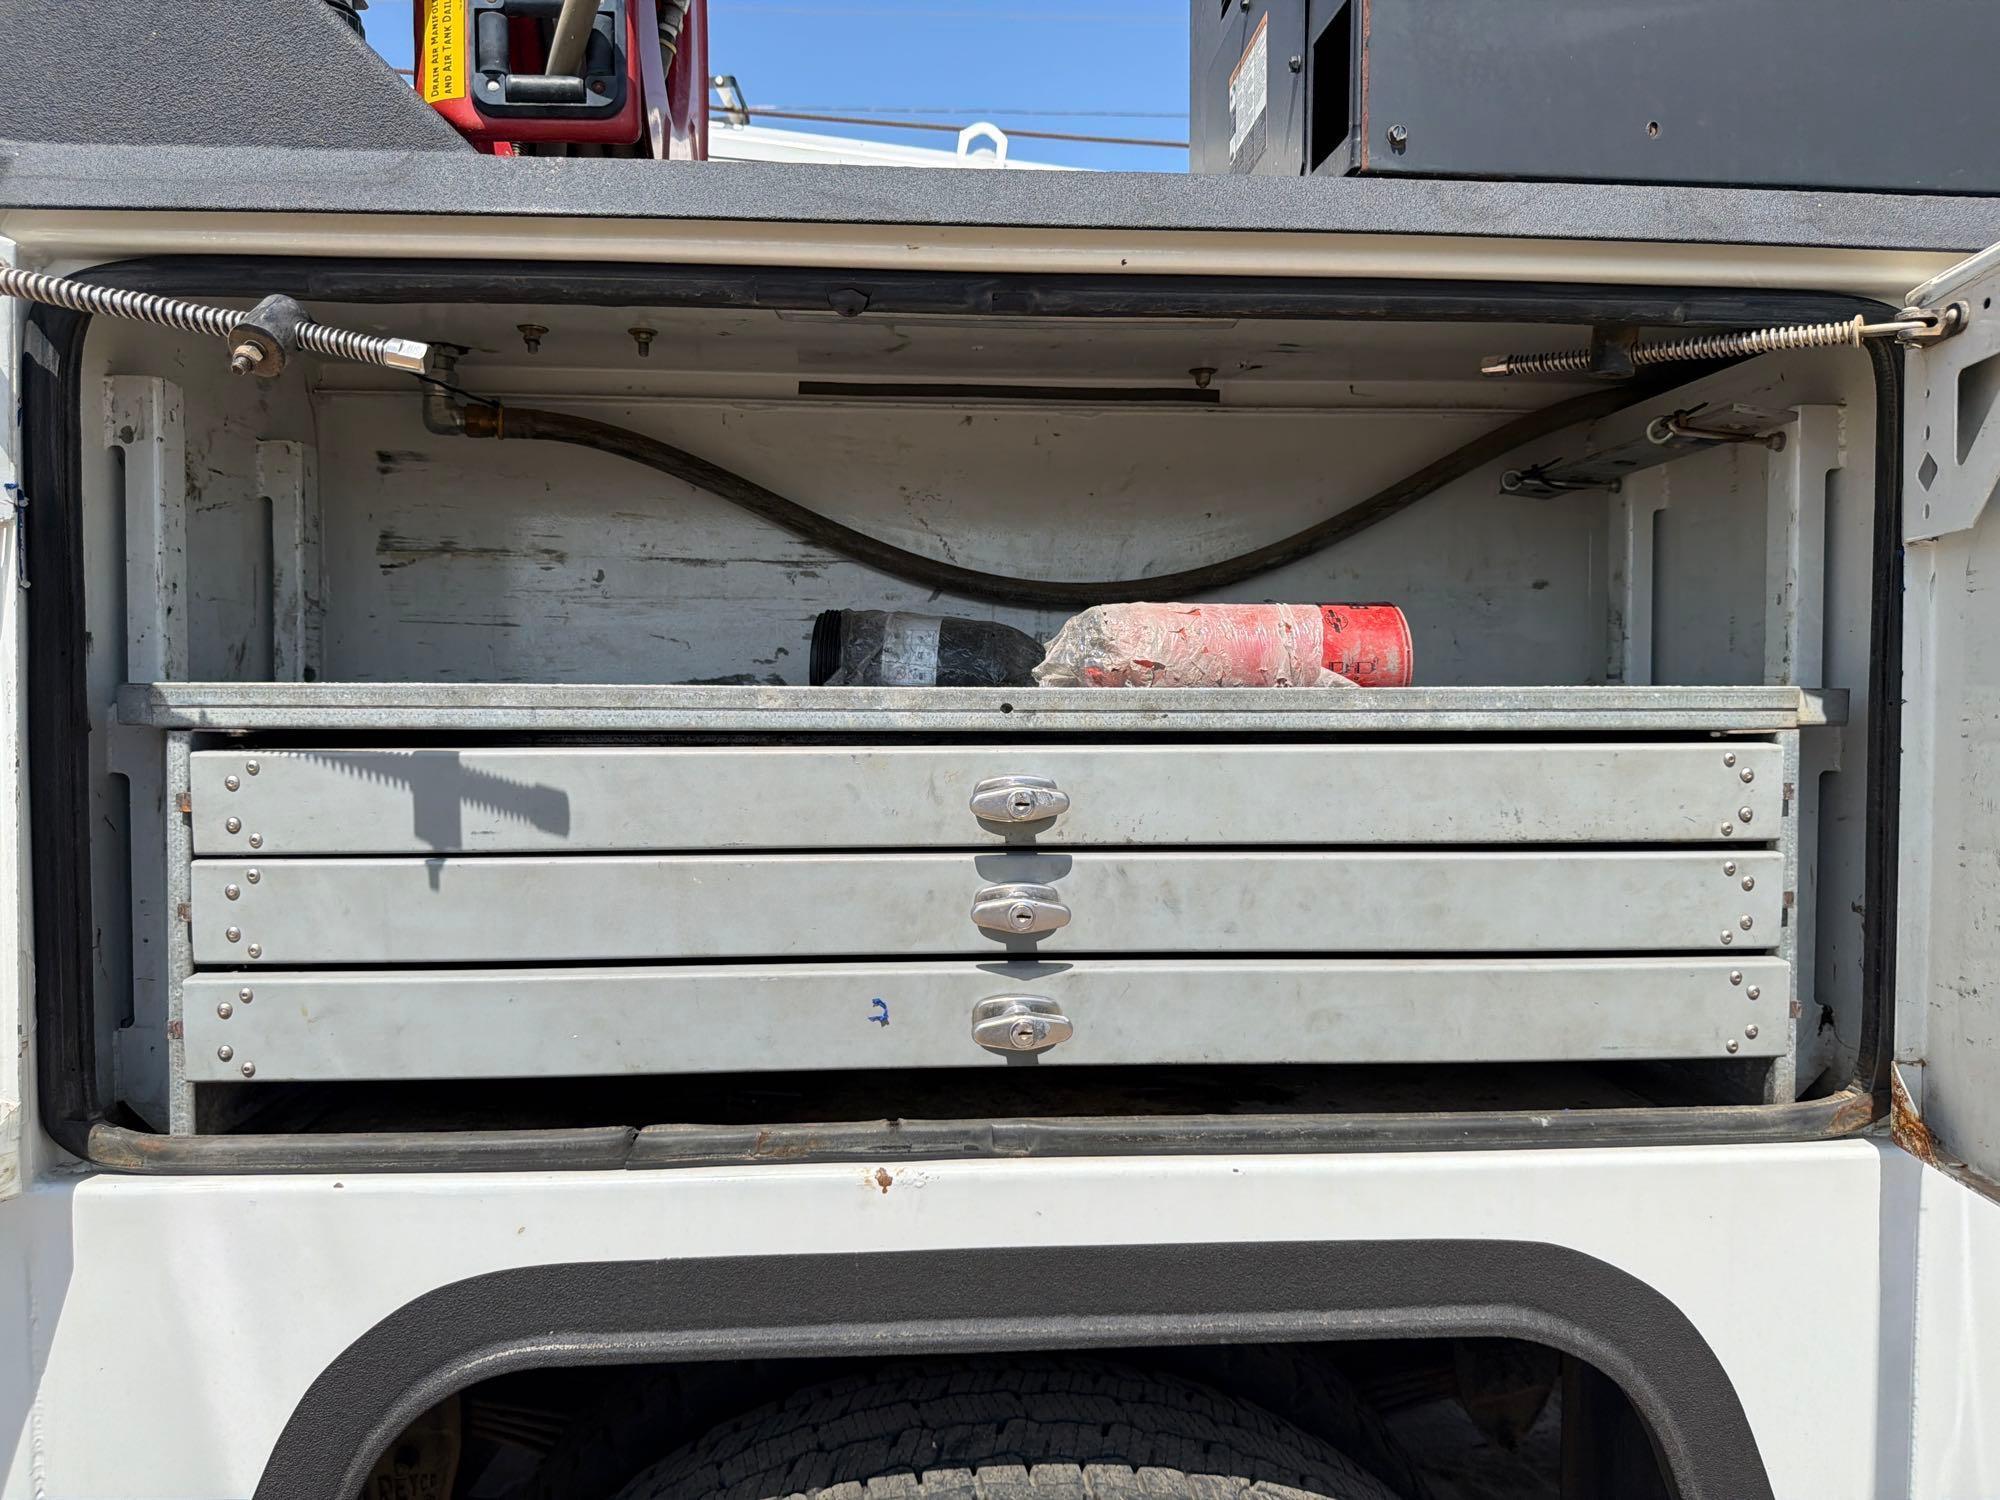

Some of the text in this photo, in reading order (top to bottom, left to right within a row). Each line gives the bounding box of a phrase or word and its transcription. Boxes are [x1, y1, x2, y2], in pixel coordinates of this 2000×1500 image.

[442, 25, 452, 53] TANK
[431, 47, 439, 64] AIR
[442, 54, 452, 72] AIR
[430, 67, 440, 98] DRAIN
